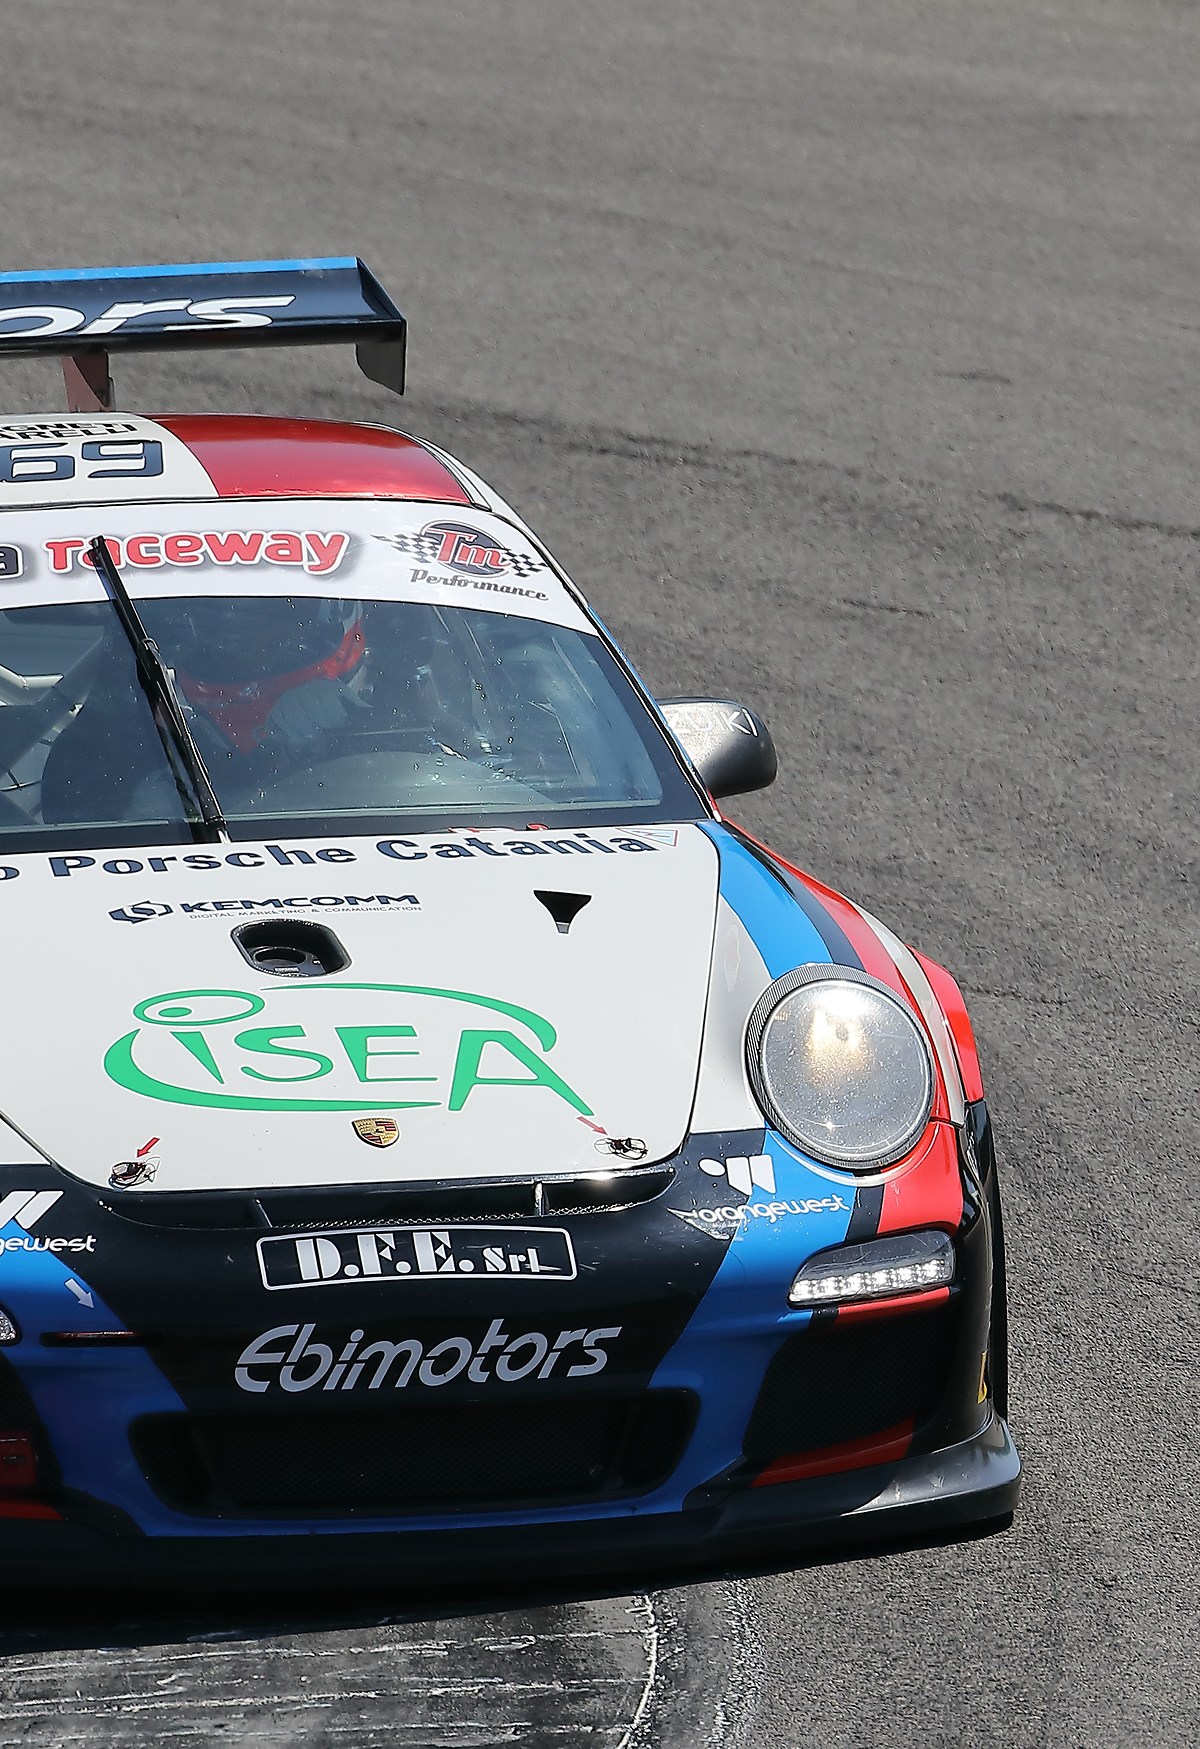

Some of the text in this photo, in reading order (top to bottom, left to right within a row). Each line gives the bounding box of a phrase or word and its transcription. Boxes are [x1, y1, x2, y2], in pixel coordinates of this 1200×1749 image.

[410, 568, 549, 601] Performance
[47, 844, 357, 878] Porsche
[375, 832, 660, 861] Catania
[179, 895, 421, 912] KEMCOMM
[189, 911, 235, 919] DIGITAL
[238, 908, 306, 917] MARKETING
[324, 906, 422, 914] COMMUNICATION
[698, 1194, 850, 1224] orangewest
[295, 1231, 542, 1281] D.F.E. Srl
[234, 1318, 623, 1393] Ebimotors
